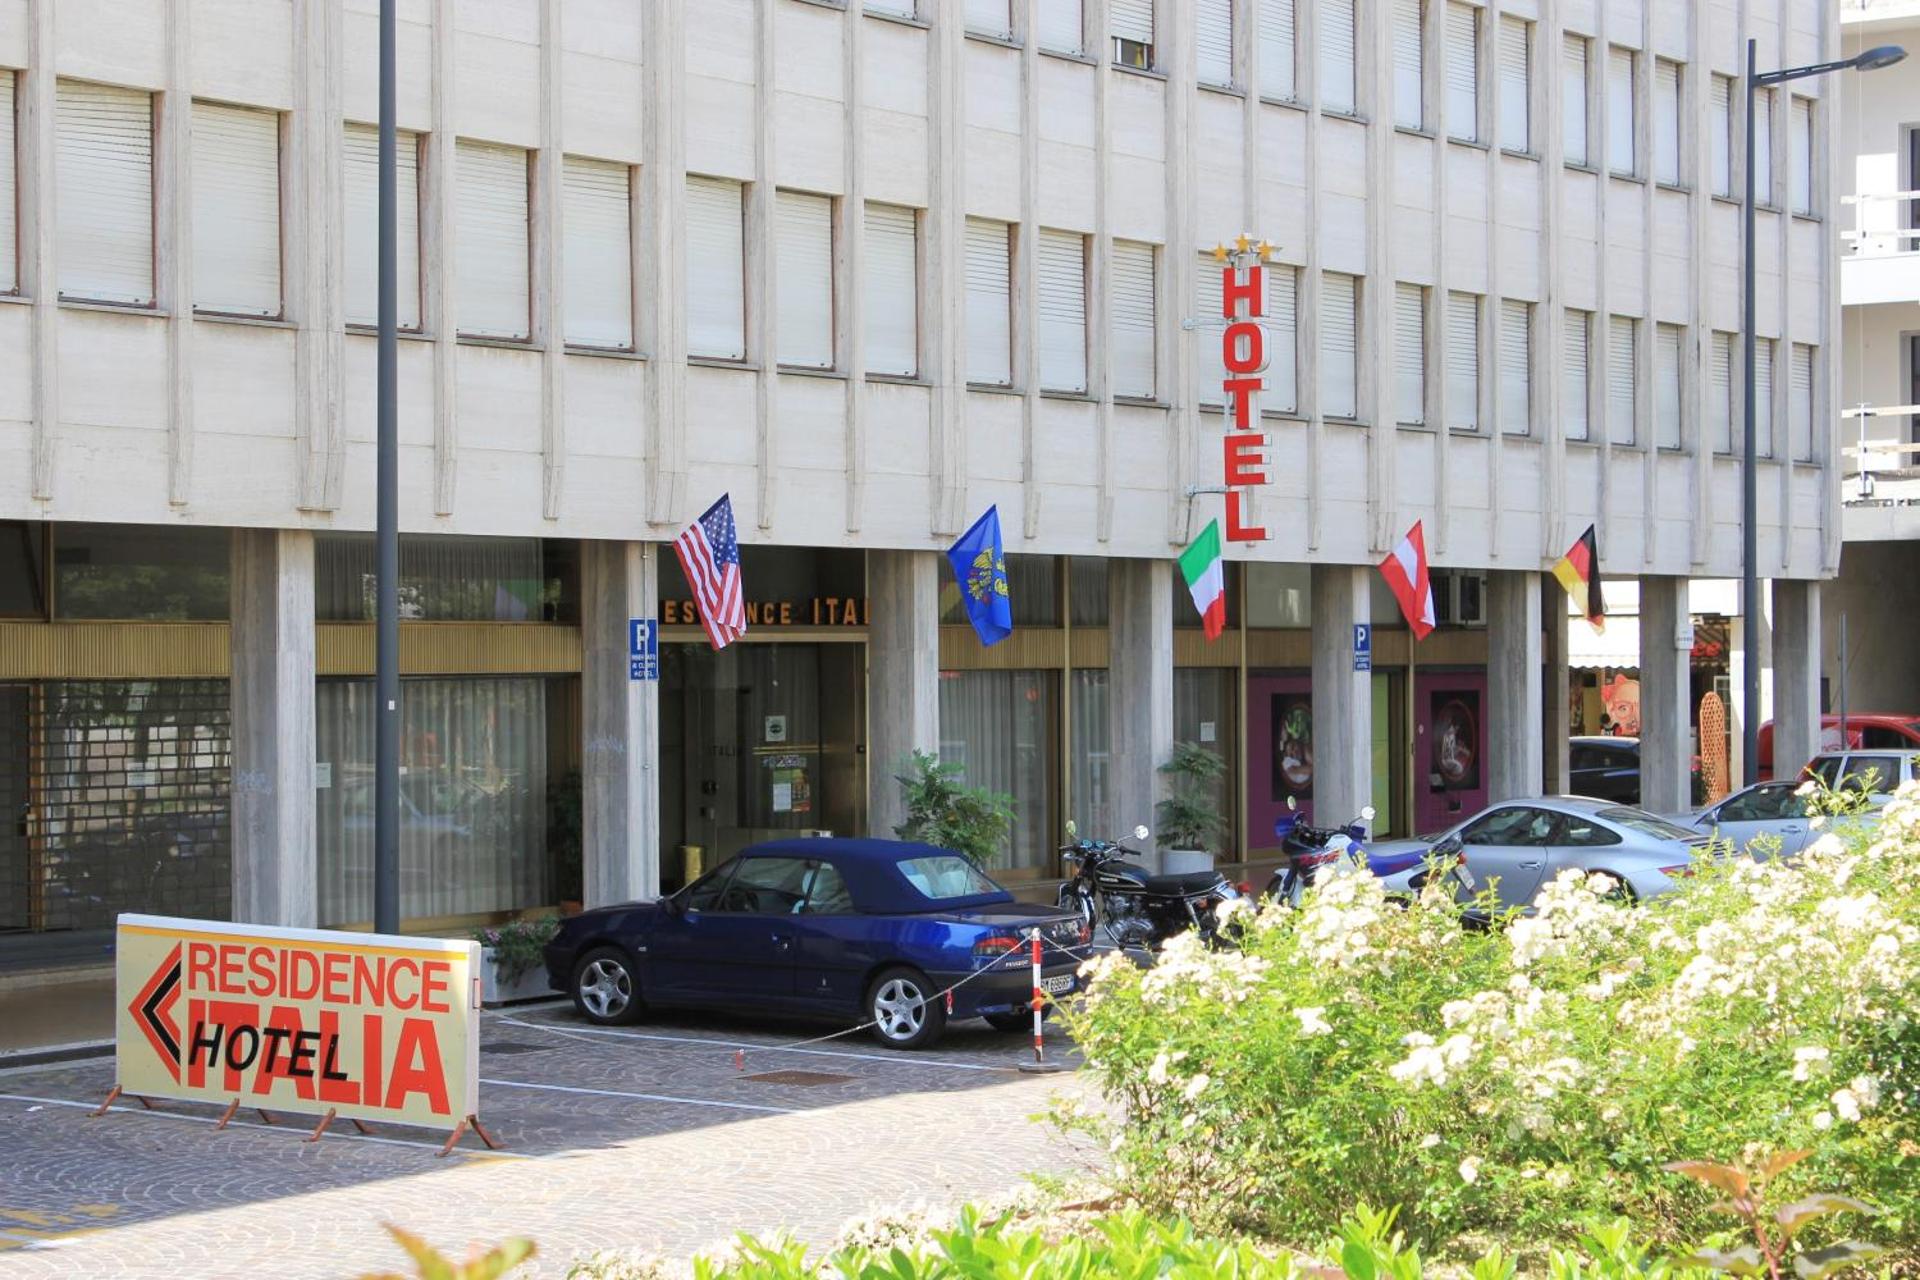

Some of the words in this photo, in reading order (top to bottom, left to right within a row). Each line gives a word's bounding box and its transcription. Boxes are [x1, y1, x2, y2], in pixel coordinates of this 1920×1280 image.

[1223, 265, 1270, 542] HOTEL
[636, 623, 650, 651] P
[664, 600, 792, 625] ESNCE
[814, 598, 870, 625] ITA
[1357, 626, 1366, 649] P
[188, 941, 451, 1014] RESIDENCE
[187, 999, 451, 1116] ITALIA
[188, 1020, 349, 1082] HOTEL
